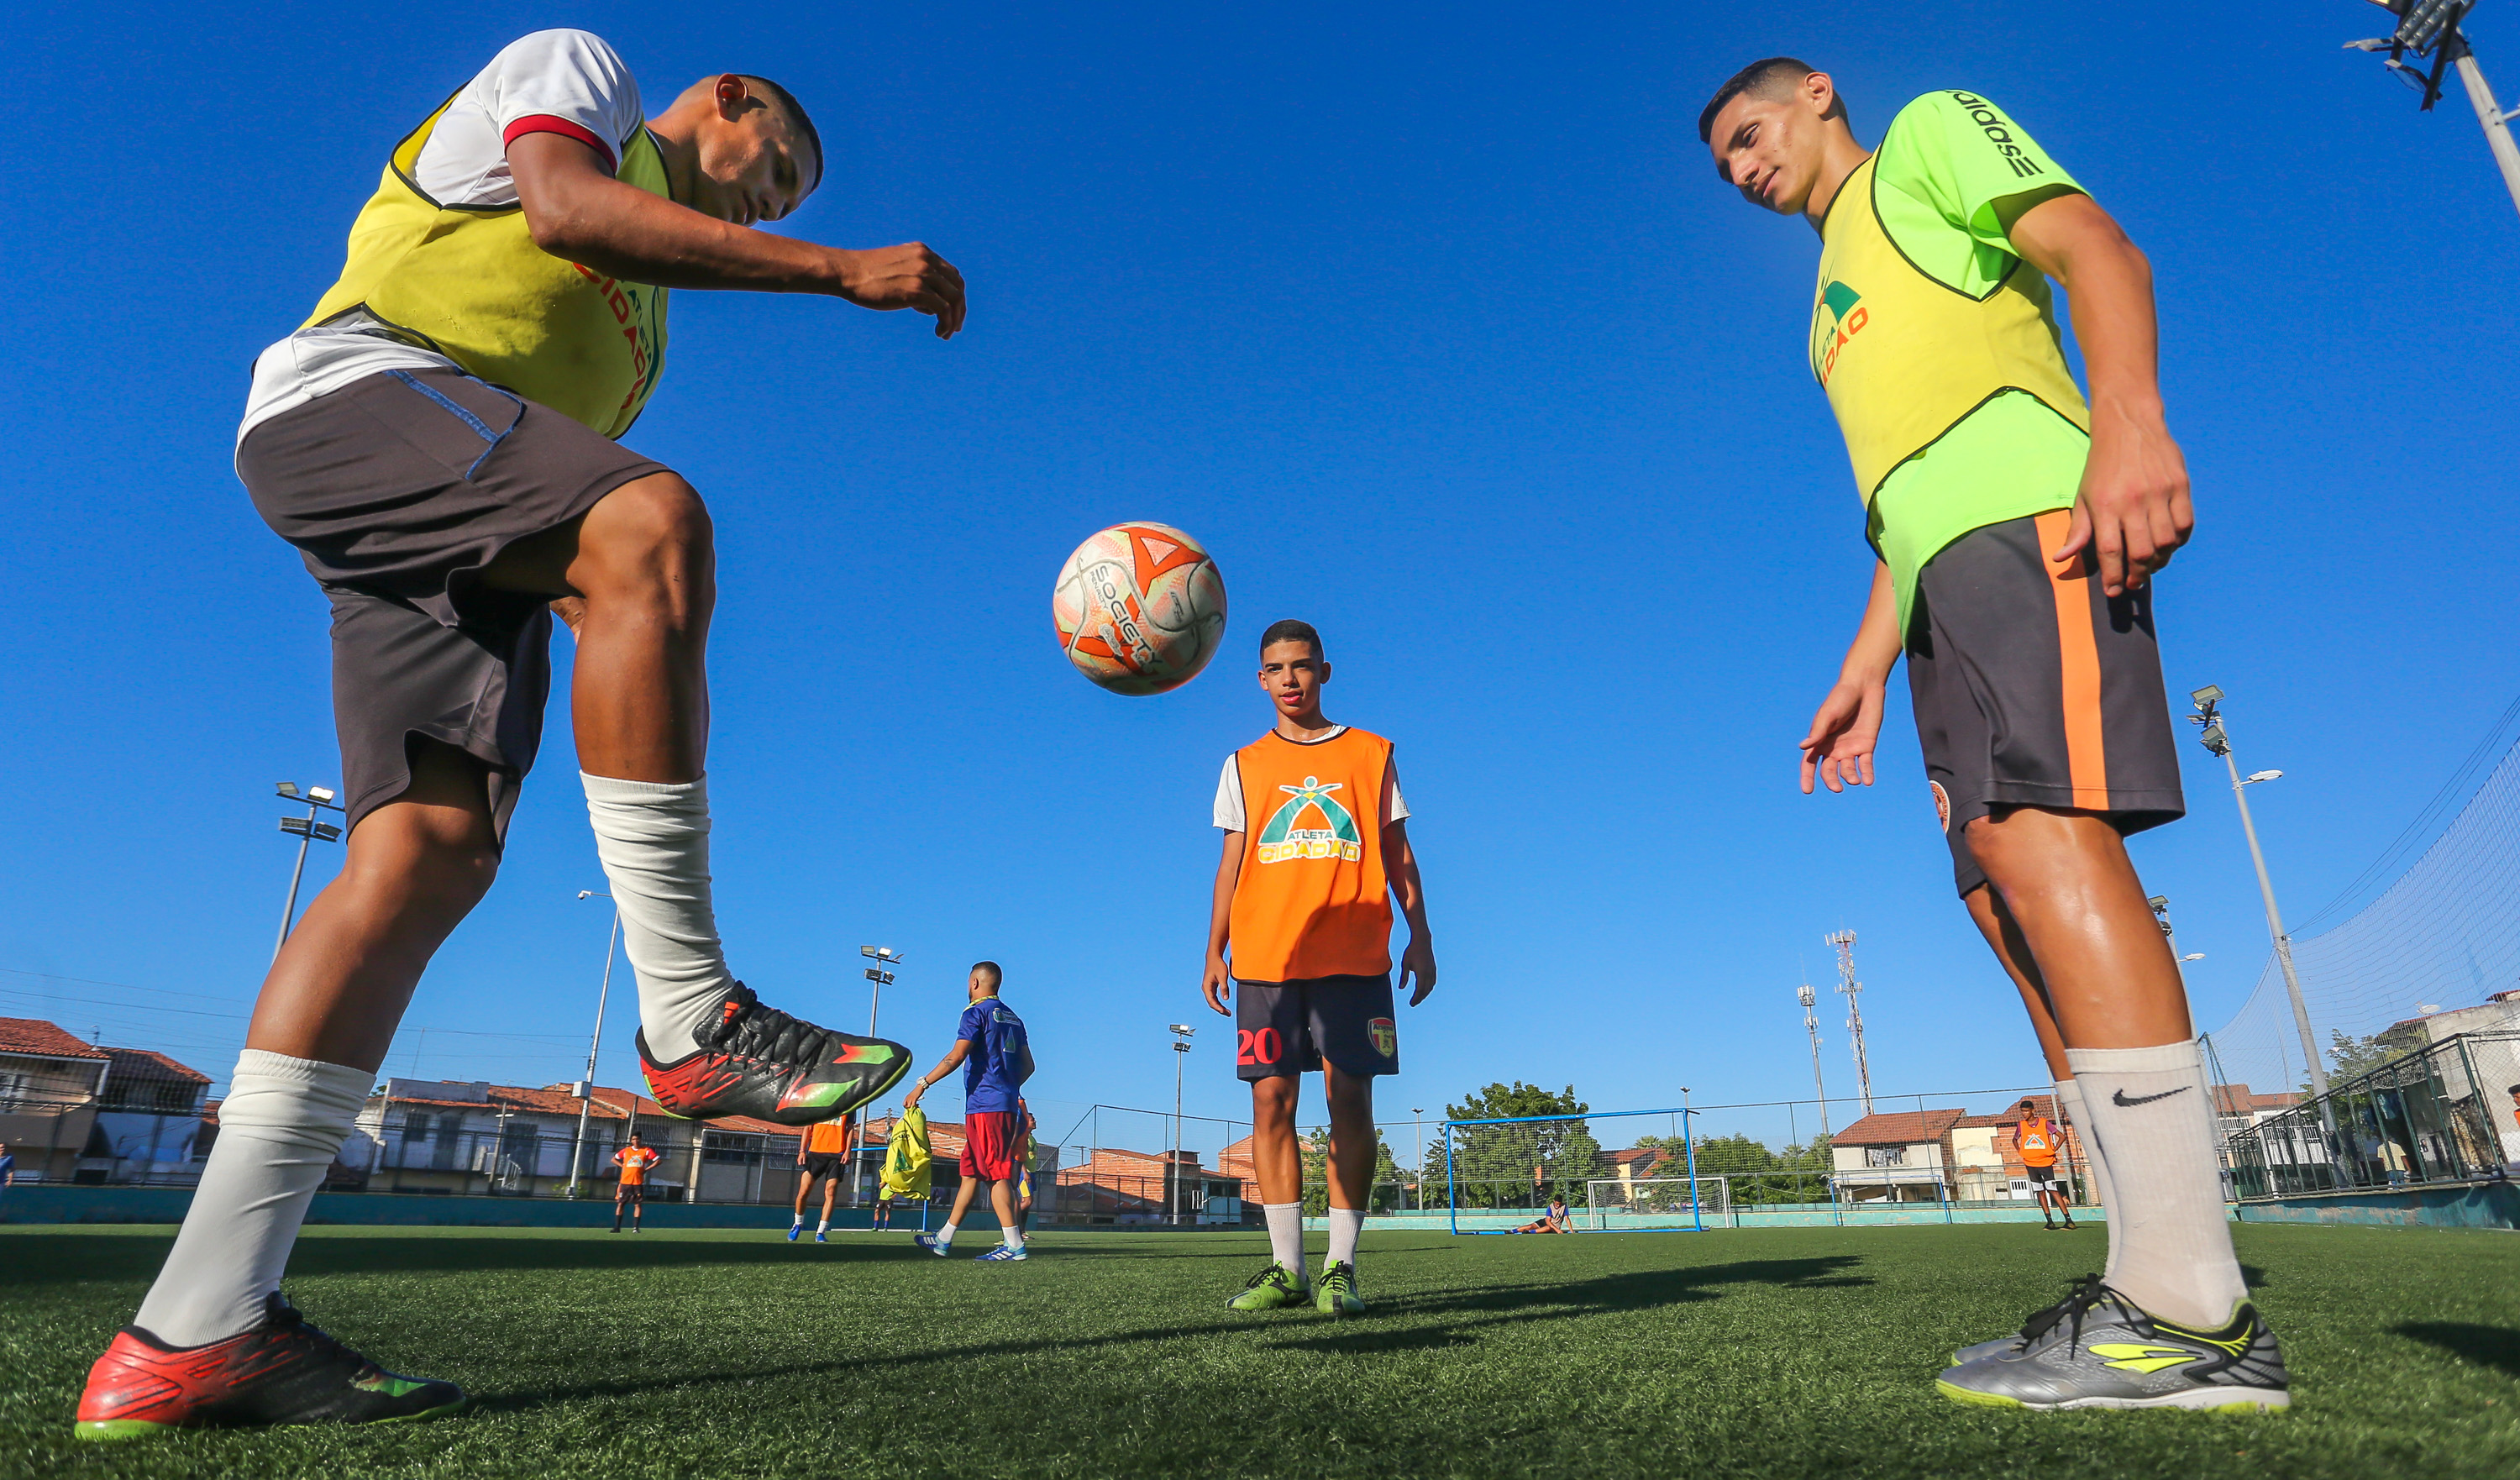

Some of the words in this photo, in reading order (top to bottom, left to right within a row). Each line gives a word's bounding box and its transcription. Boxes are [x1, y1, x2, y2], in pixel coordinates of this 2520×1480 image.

[1945, 90, 2022, 157] didas
[627, 289, 652, 366] ATLETA
[1089, 571, 1109, 610] PENALTY
[1095, 565, 1163, 664] SOCIETY
[1289, 830, 1333, 840] ATLETA
[1237, 1027, 1282, 1066] 20
